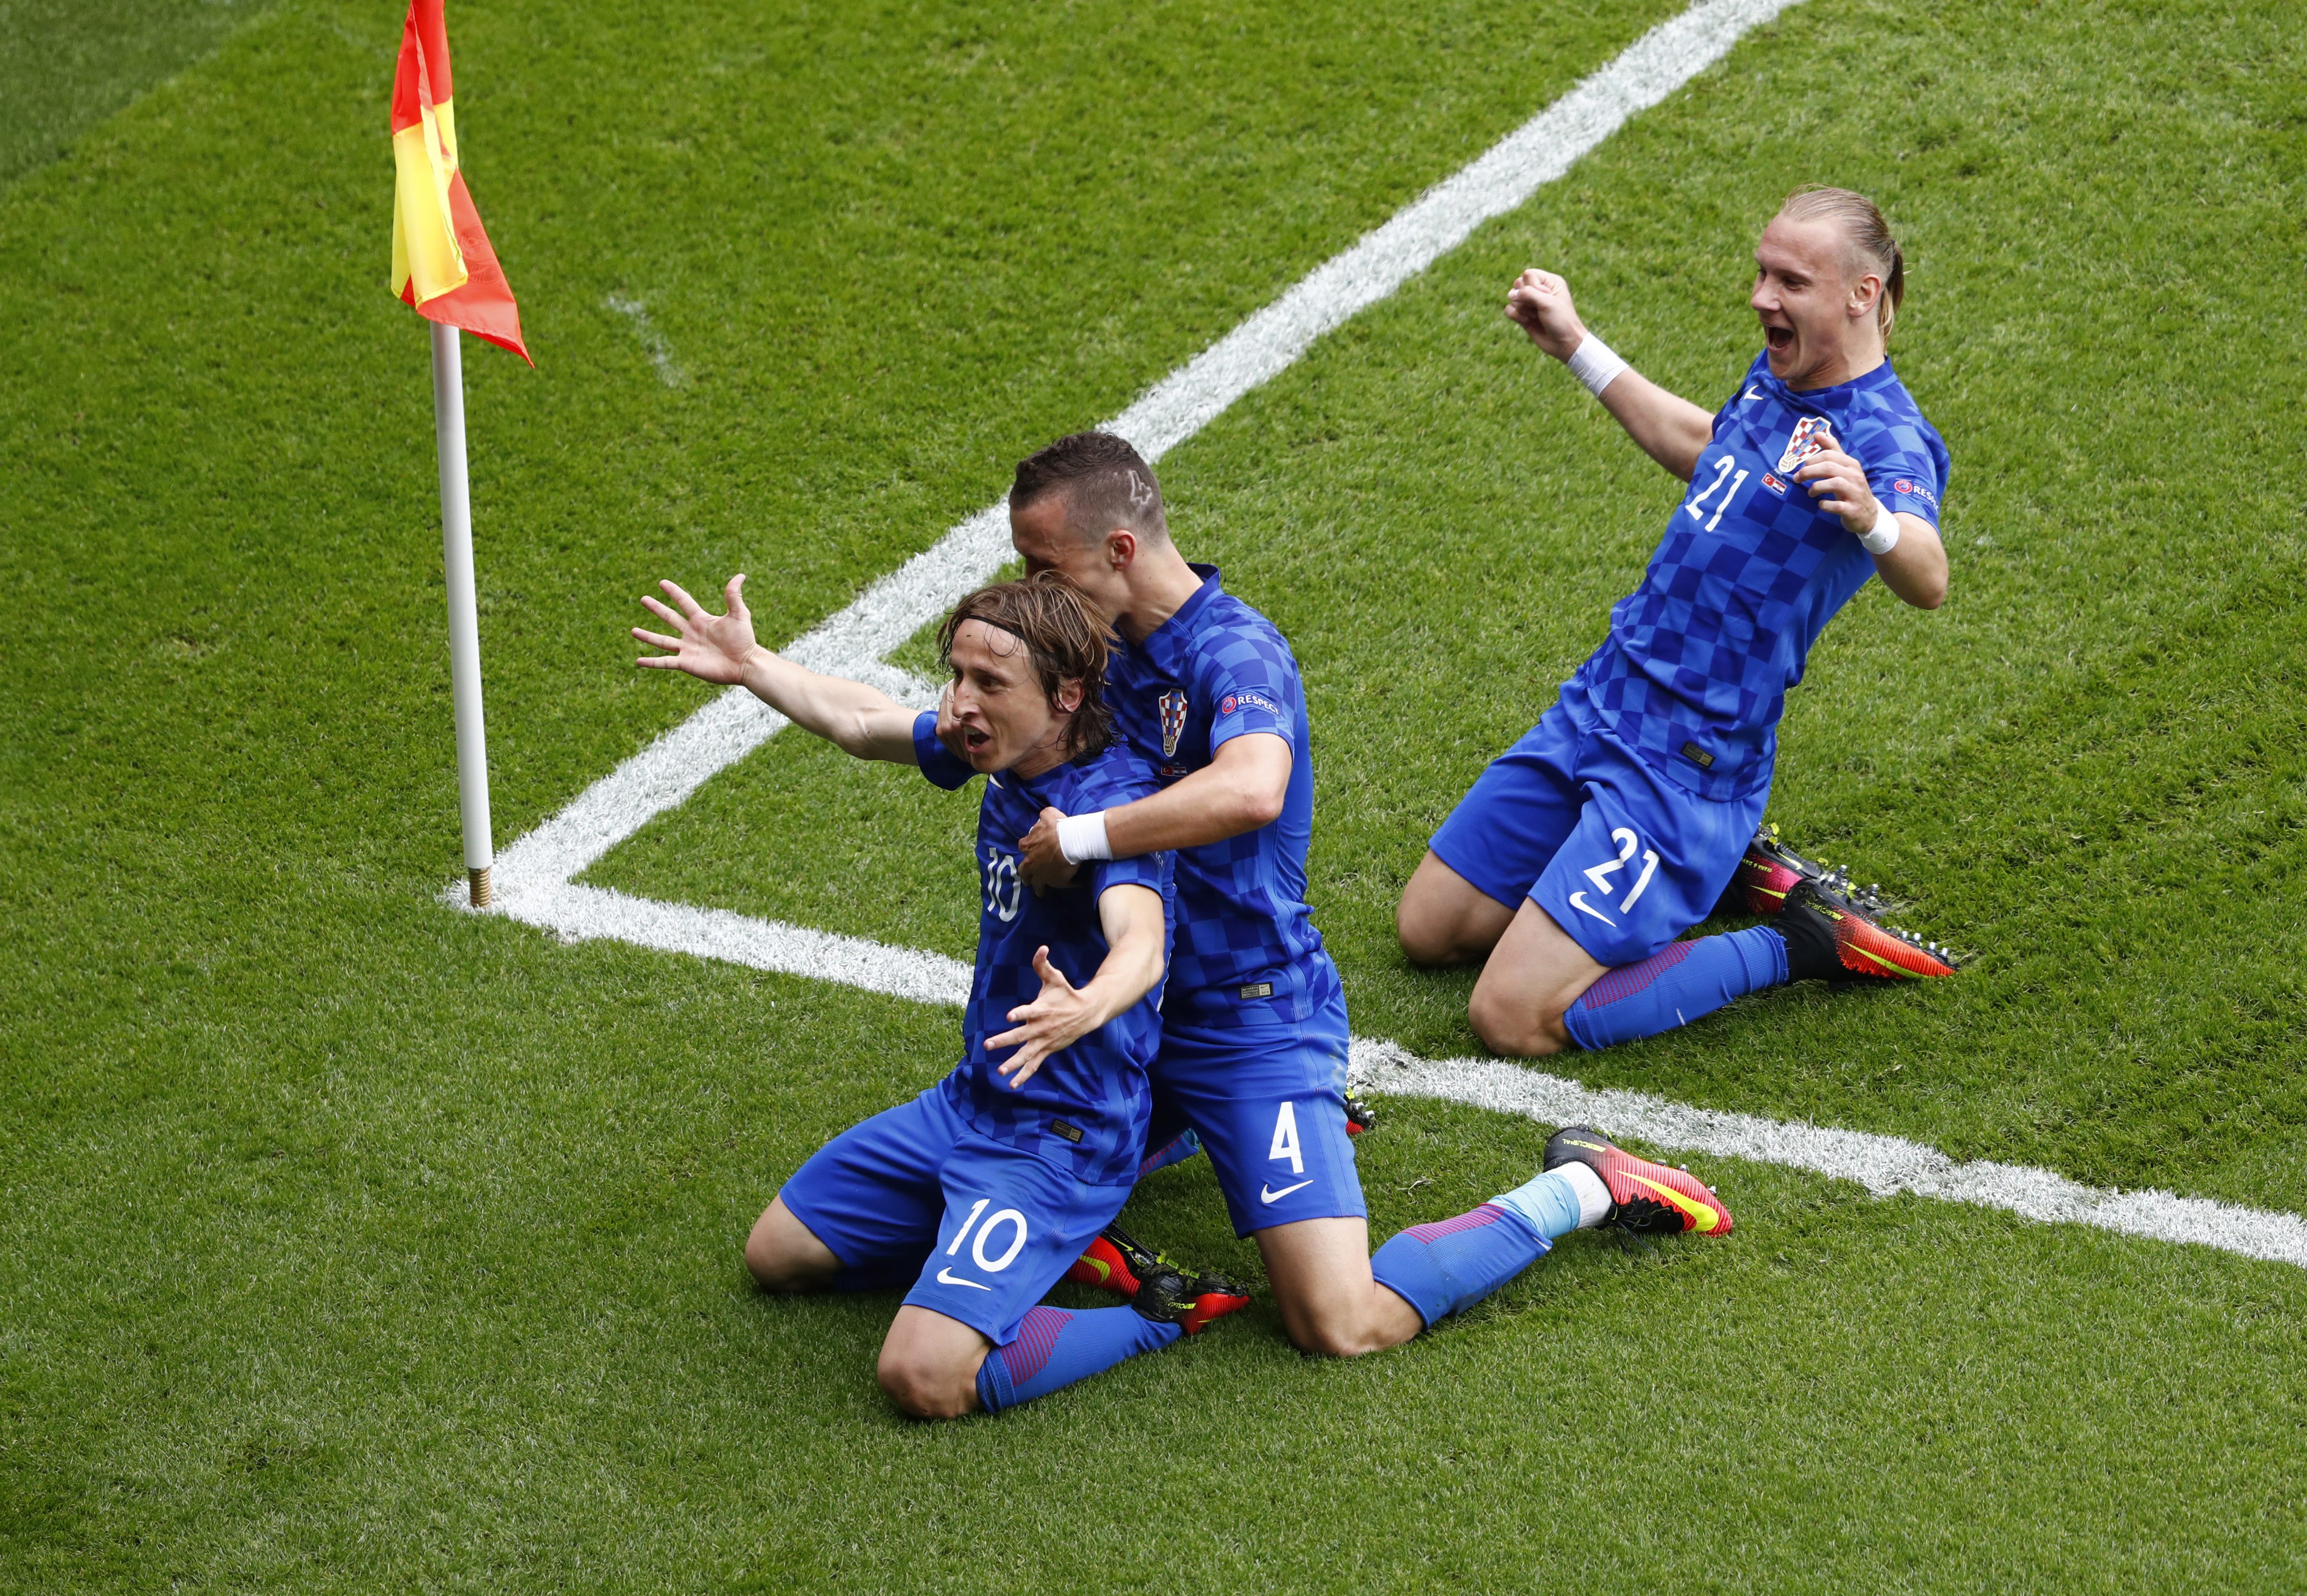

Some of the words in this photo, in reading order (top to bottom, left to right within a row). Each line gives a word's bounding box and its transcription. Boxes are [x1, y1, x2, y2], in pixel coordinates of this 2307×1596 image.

[1685, 455, 1749, 532] 21
[1238, 695, 1279, 715] RESPECT
[987, 847, 1021, 922] 10
[1583, 828, 1659, 915] 21
[1268, 1101, 1305, 1174] 4
[946, 1198, 1027, 1272] 10
